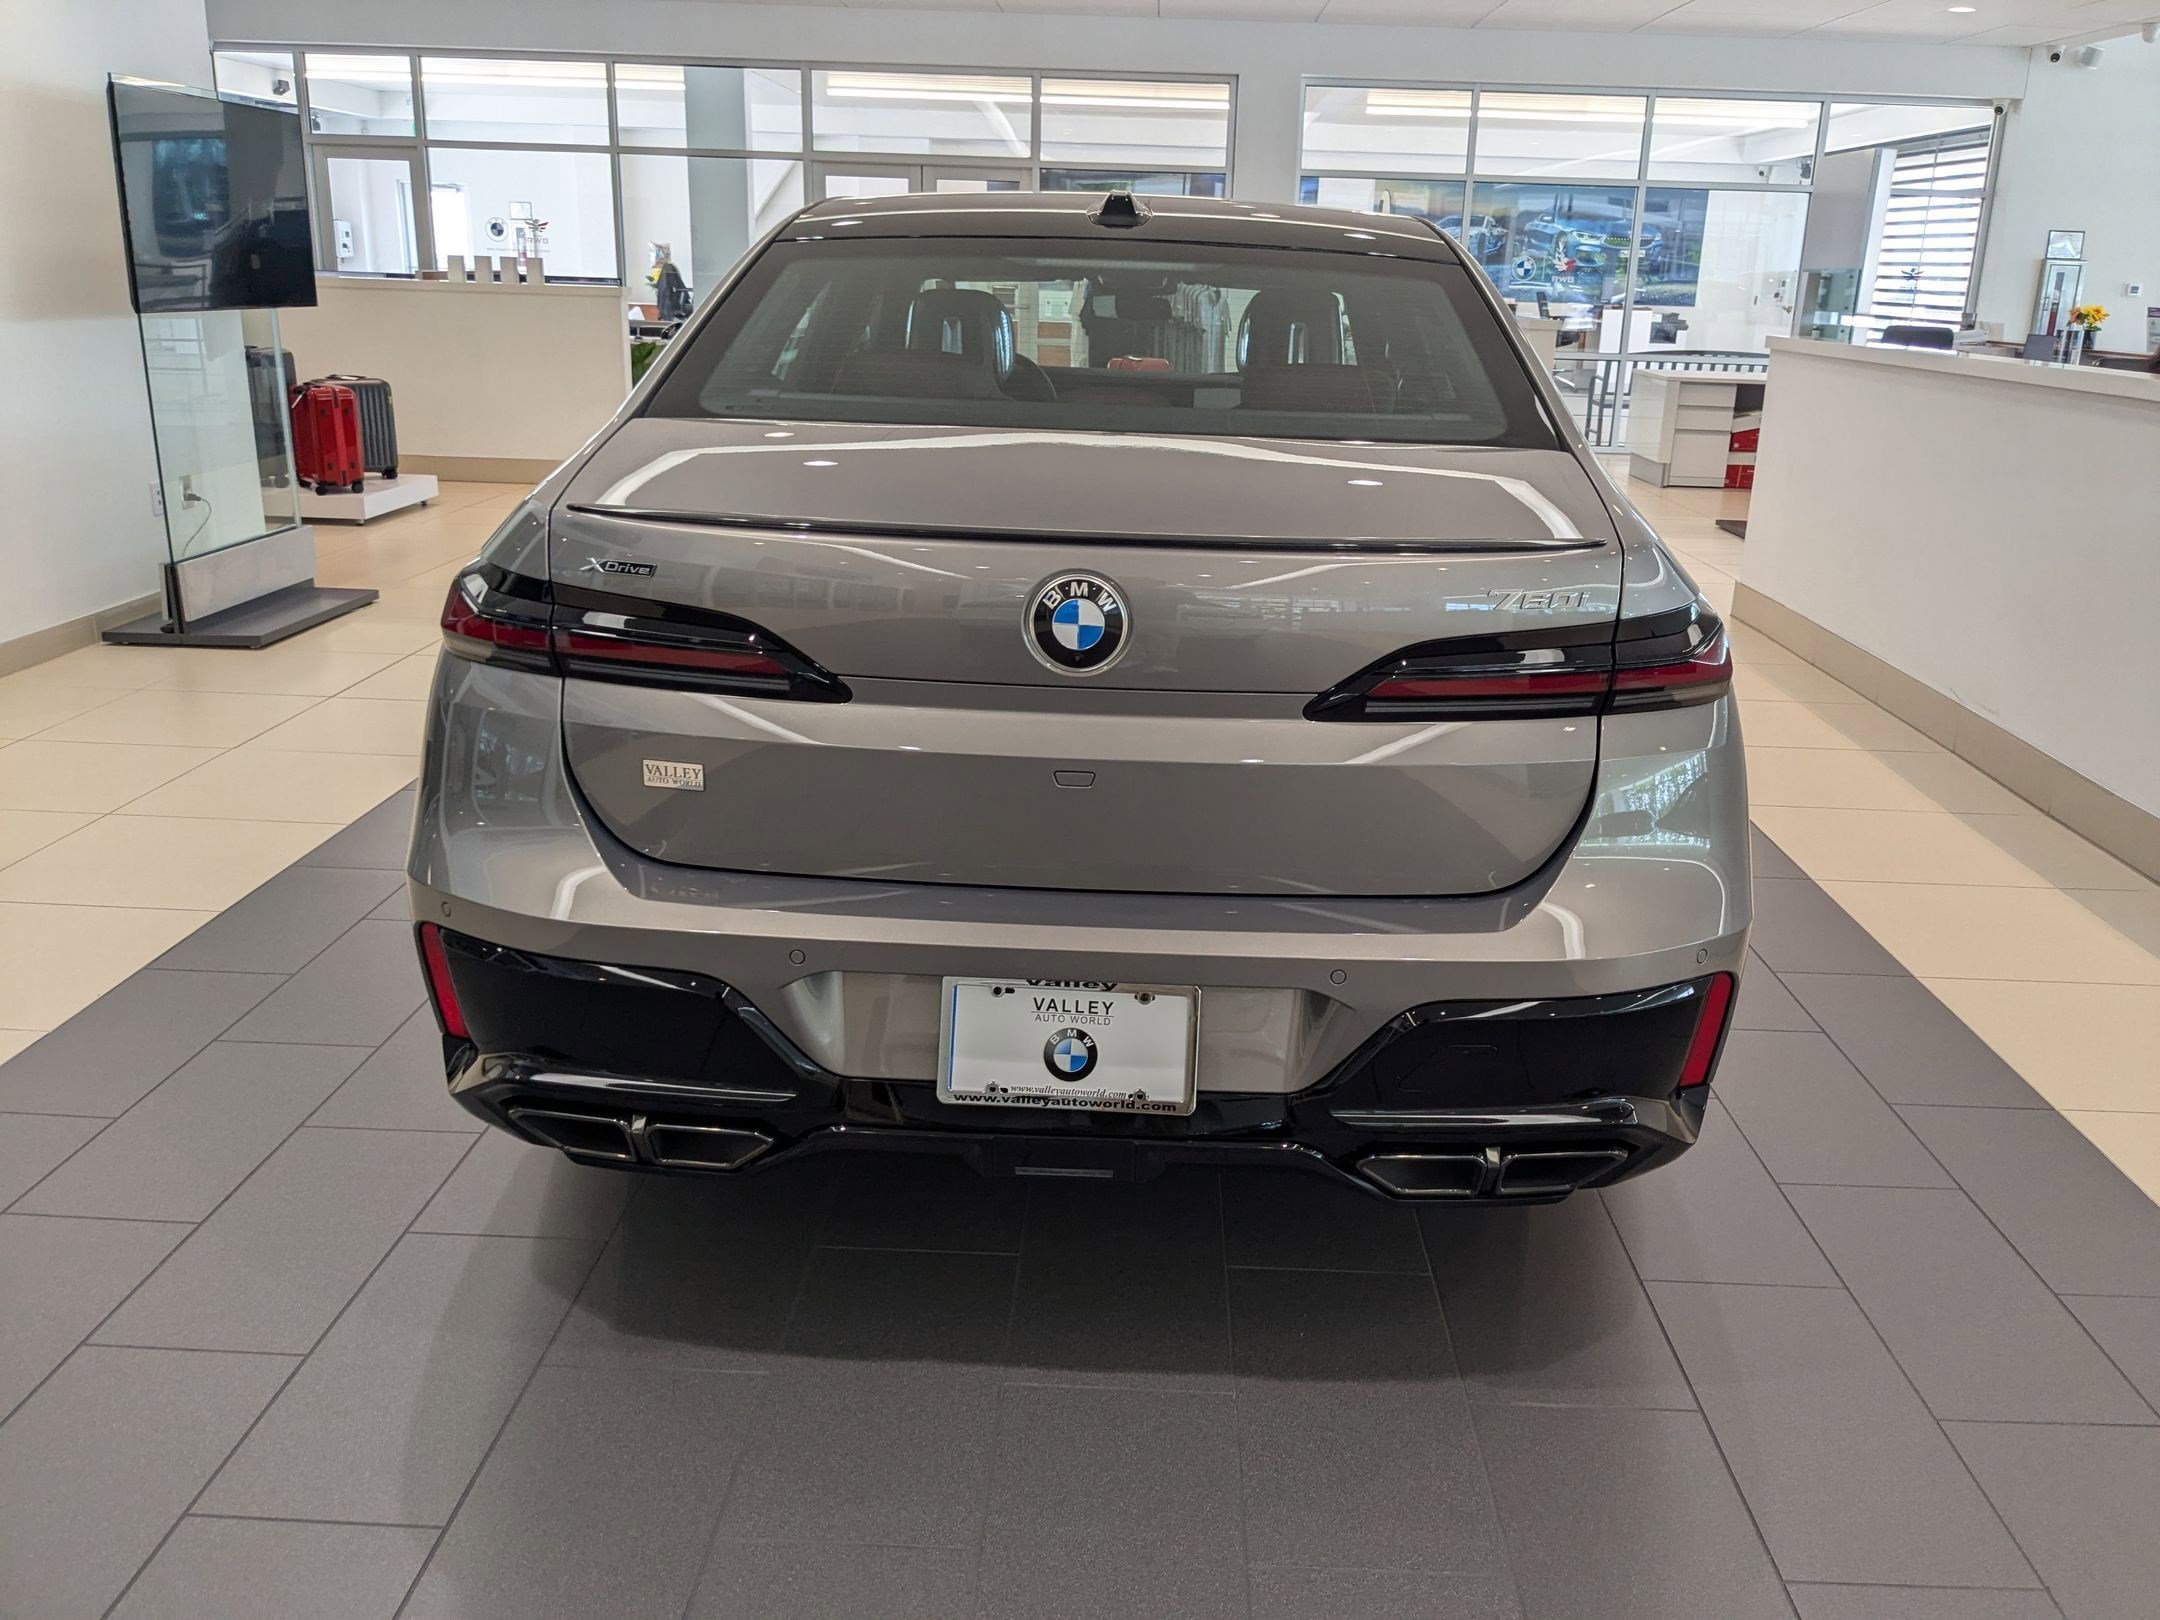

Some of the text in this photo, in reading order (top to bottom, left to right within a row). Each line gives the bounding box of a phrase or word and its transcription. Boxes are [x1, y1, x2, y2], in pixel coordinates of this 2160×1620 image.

[1042, 581, 1117, 614] BMW
[1487, 589, 1591, 611] 760i
[645, 763, 701, 780] VALLEY
[647, 776, 701, 788] AUTO WORLD
[1033, 997, 1114, 1015] VALLEY
[1034, 1013, 1111, 1026] AUTO WORLD
[1049, 1029, 1095, 1048] BMW
[1010, 1085, 1127, 1099] www.valleyautoworld.com
[953, 1093, 1177, 1112] www.valleyautoworld.com
